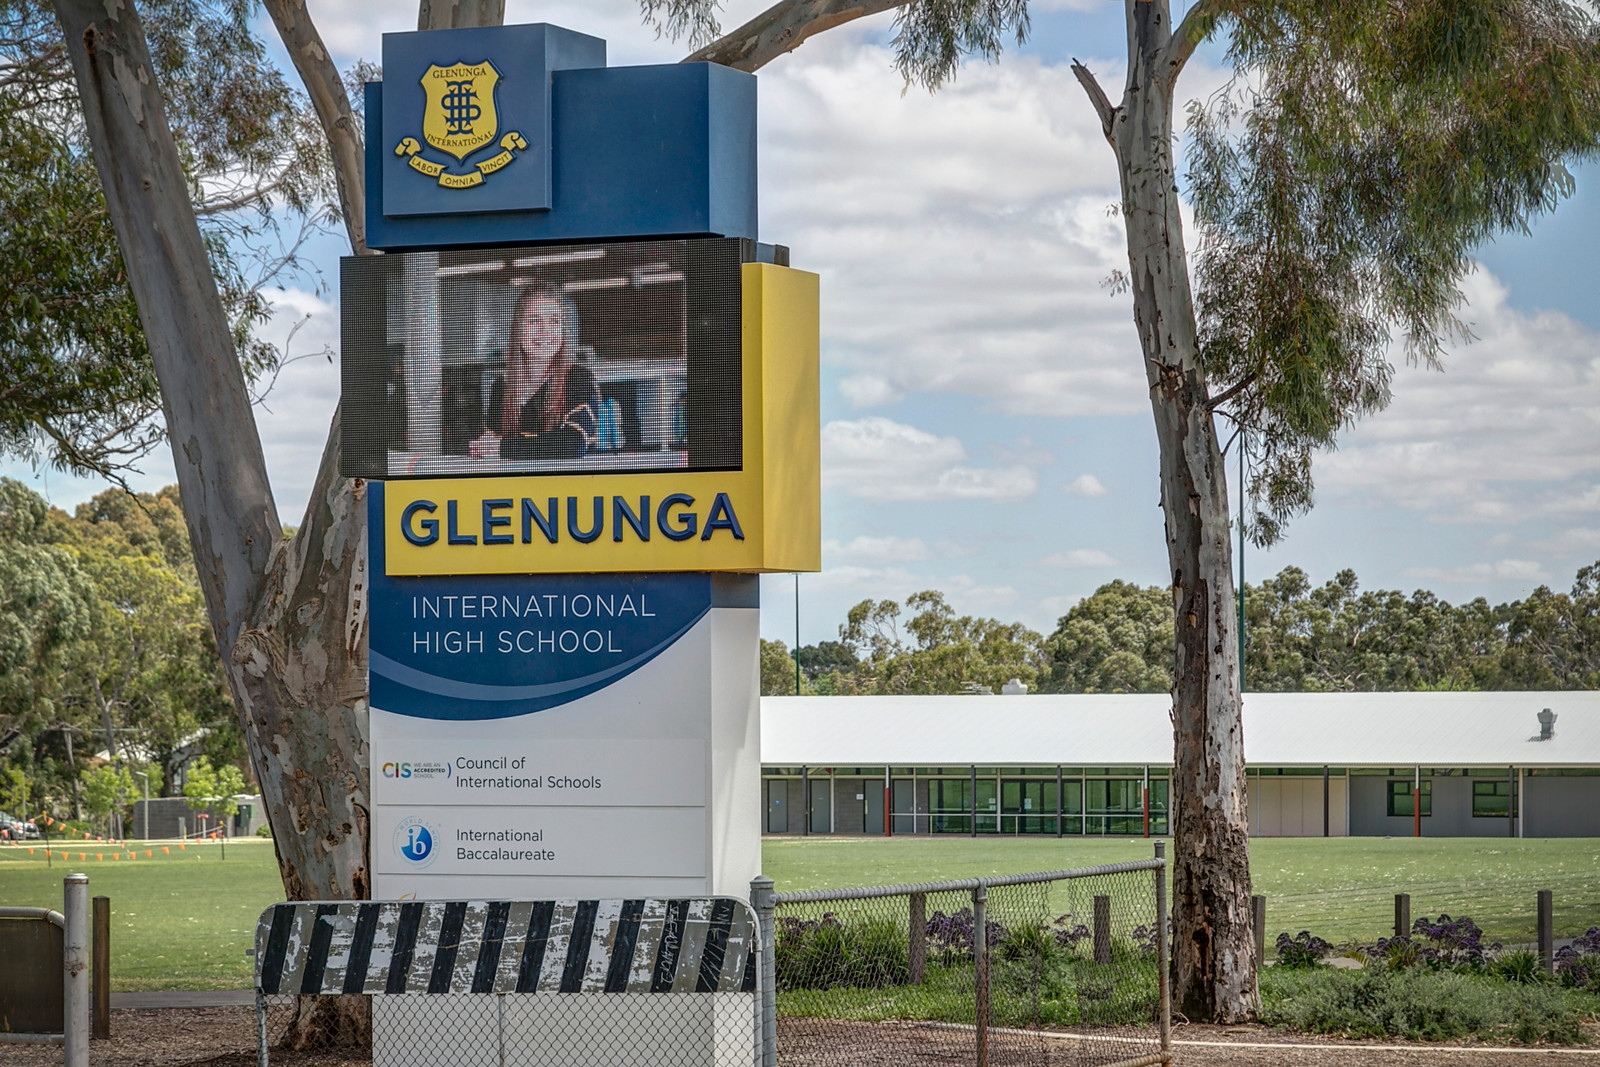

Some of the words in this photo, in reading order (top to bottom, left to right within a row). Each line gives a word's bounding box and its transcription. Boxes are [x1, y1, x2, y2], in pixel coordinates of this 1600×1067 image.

[432, 67, 487, 78] GLENUNGA
[426, 131, 494, 147] INTERNATIONAL
[410, 157, 439, 175] LABOR
[444, 176, 475, 186] OMNIA
[482, 153, 510, 172] VINCIT
[400, 492, 745, 547] GLENUNGA
[412, 593, 656, 619] INTERNATIONAL
[412, 630, 484, 654] HIGH
[497, 629, 623, 654] SCHOOL
[382, 762, 412, 779] CIS
[456, 756, 507, 770] Council
[511, 756, 526, 770] of
[456, 775, 543, 788] International
[547, 775, 602, 789] Schools
[456, 828, 543, 842] International
[456, 847, 555, 861] Baccalaureate
